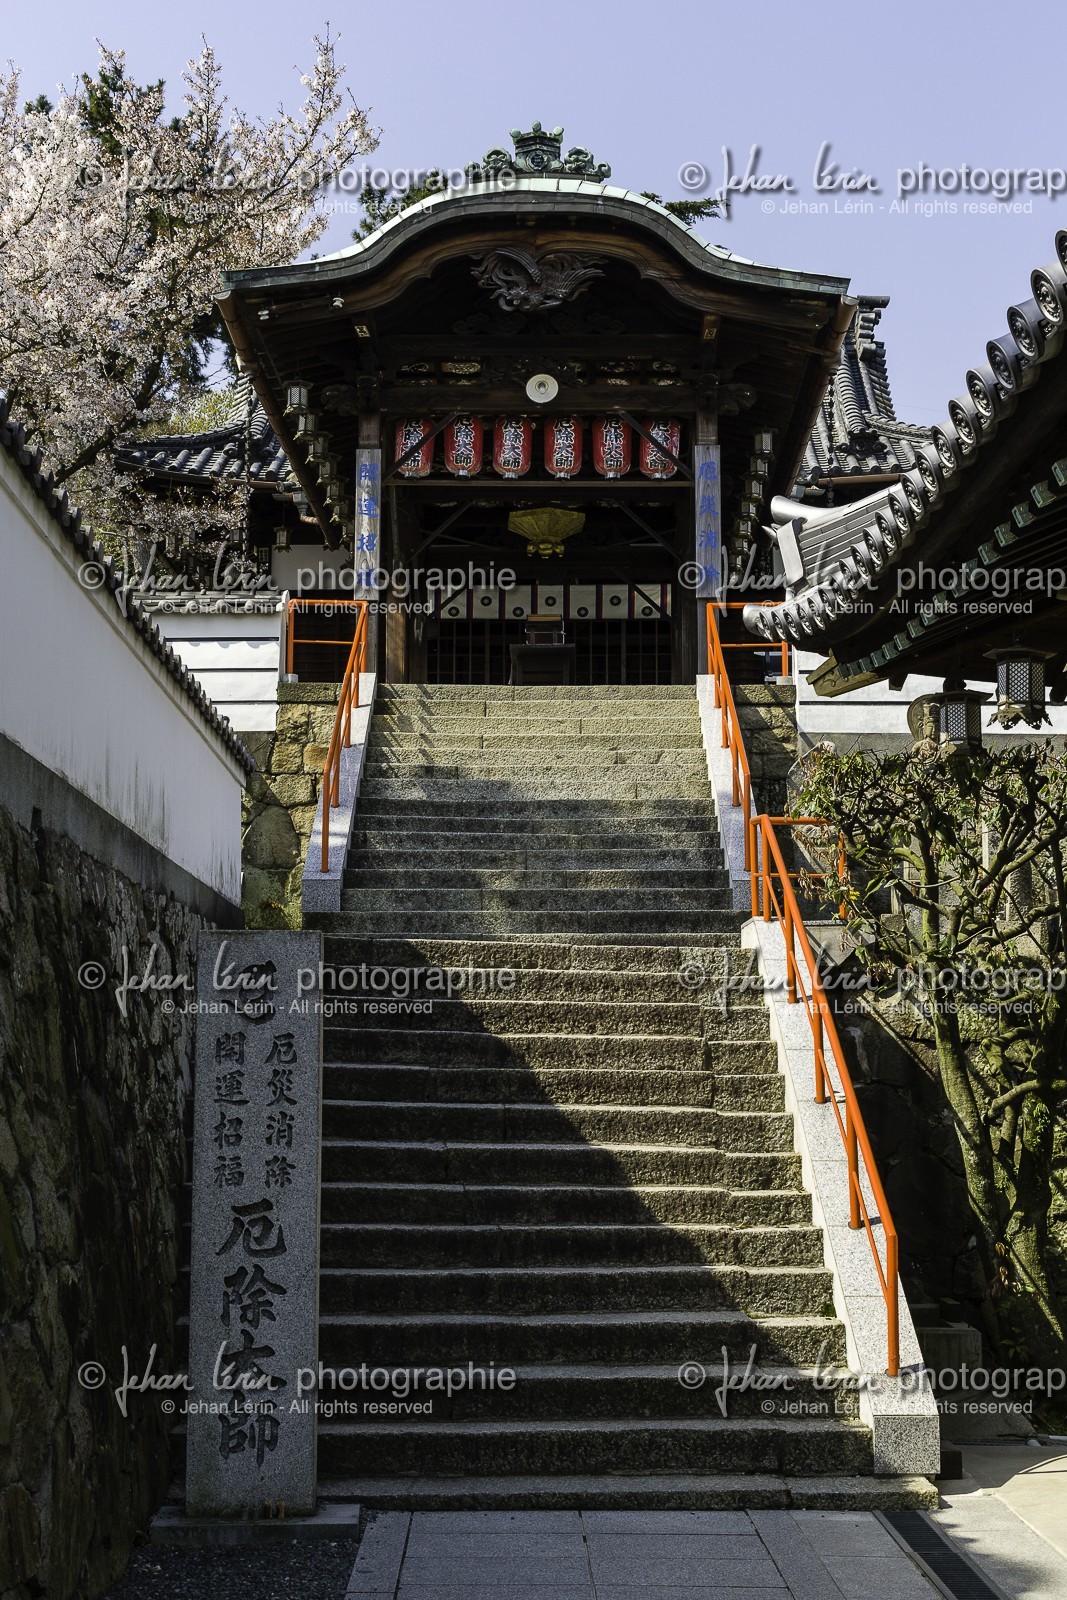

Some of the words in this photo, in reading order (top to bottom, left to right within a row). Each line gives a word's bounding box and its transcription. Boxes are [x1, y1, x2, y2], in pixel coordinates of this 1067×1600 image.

[213, 1031, 250, 1189] 開運招福
[264, 1031, 298, 1189] 厄災消除
